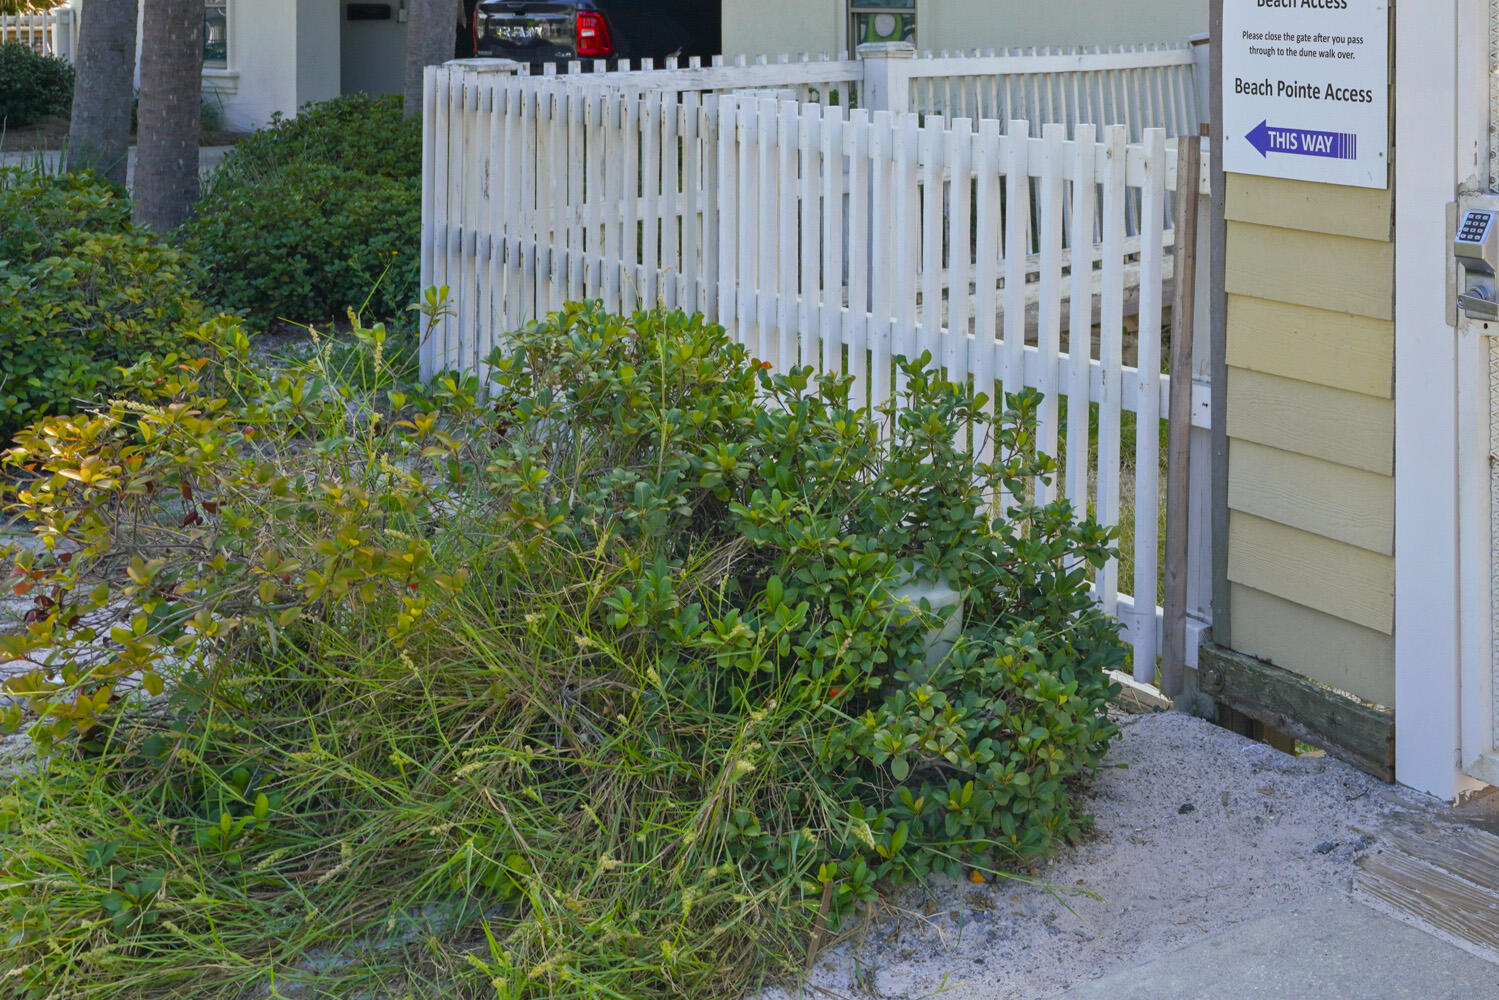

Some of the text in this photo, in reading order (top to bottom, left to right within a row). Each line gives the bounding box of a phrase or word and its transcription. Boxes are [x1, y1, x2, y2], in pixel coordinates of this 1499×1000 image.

[1242, 30, 1364, 46] Please close the gate after you pass
[1249, 46, 1356, 59] through to the dune walk over.
[1235, 77, 1373, 103] Beach Pointe Access
[1268, 130, 1334, 153] THIS WAY
